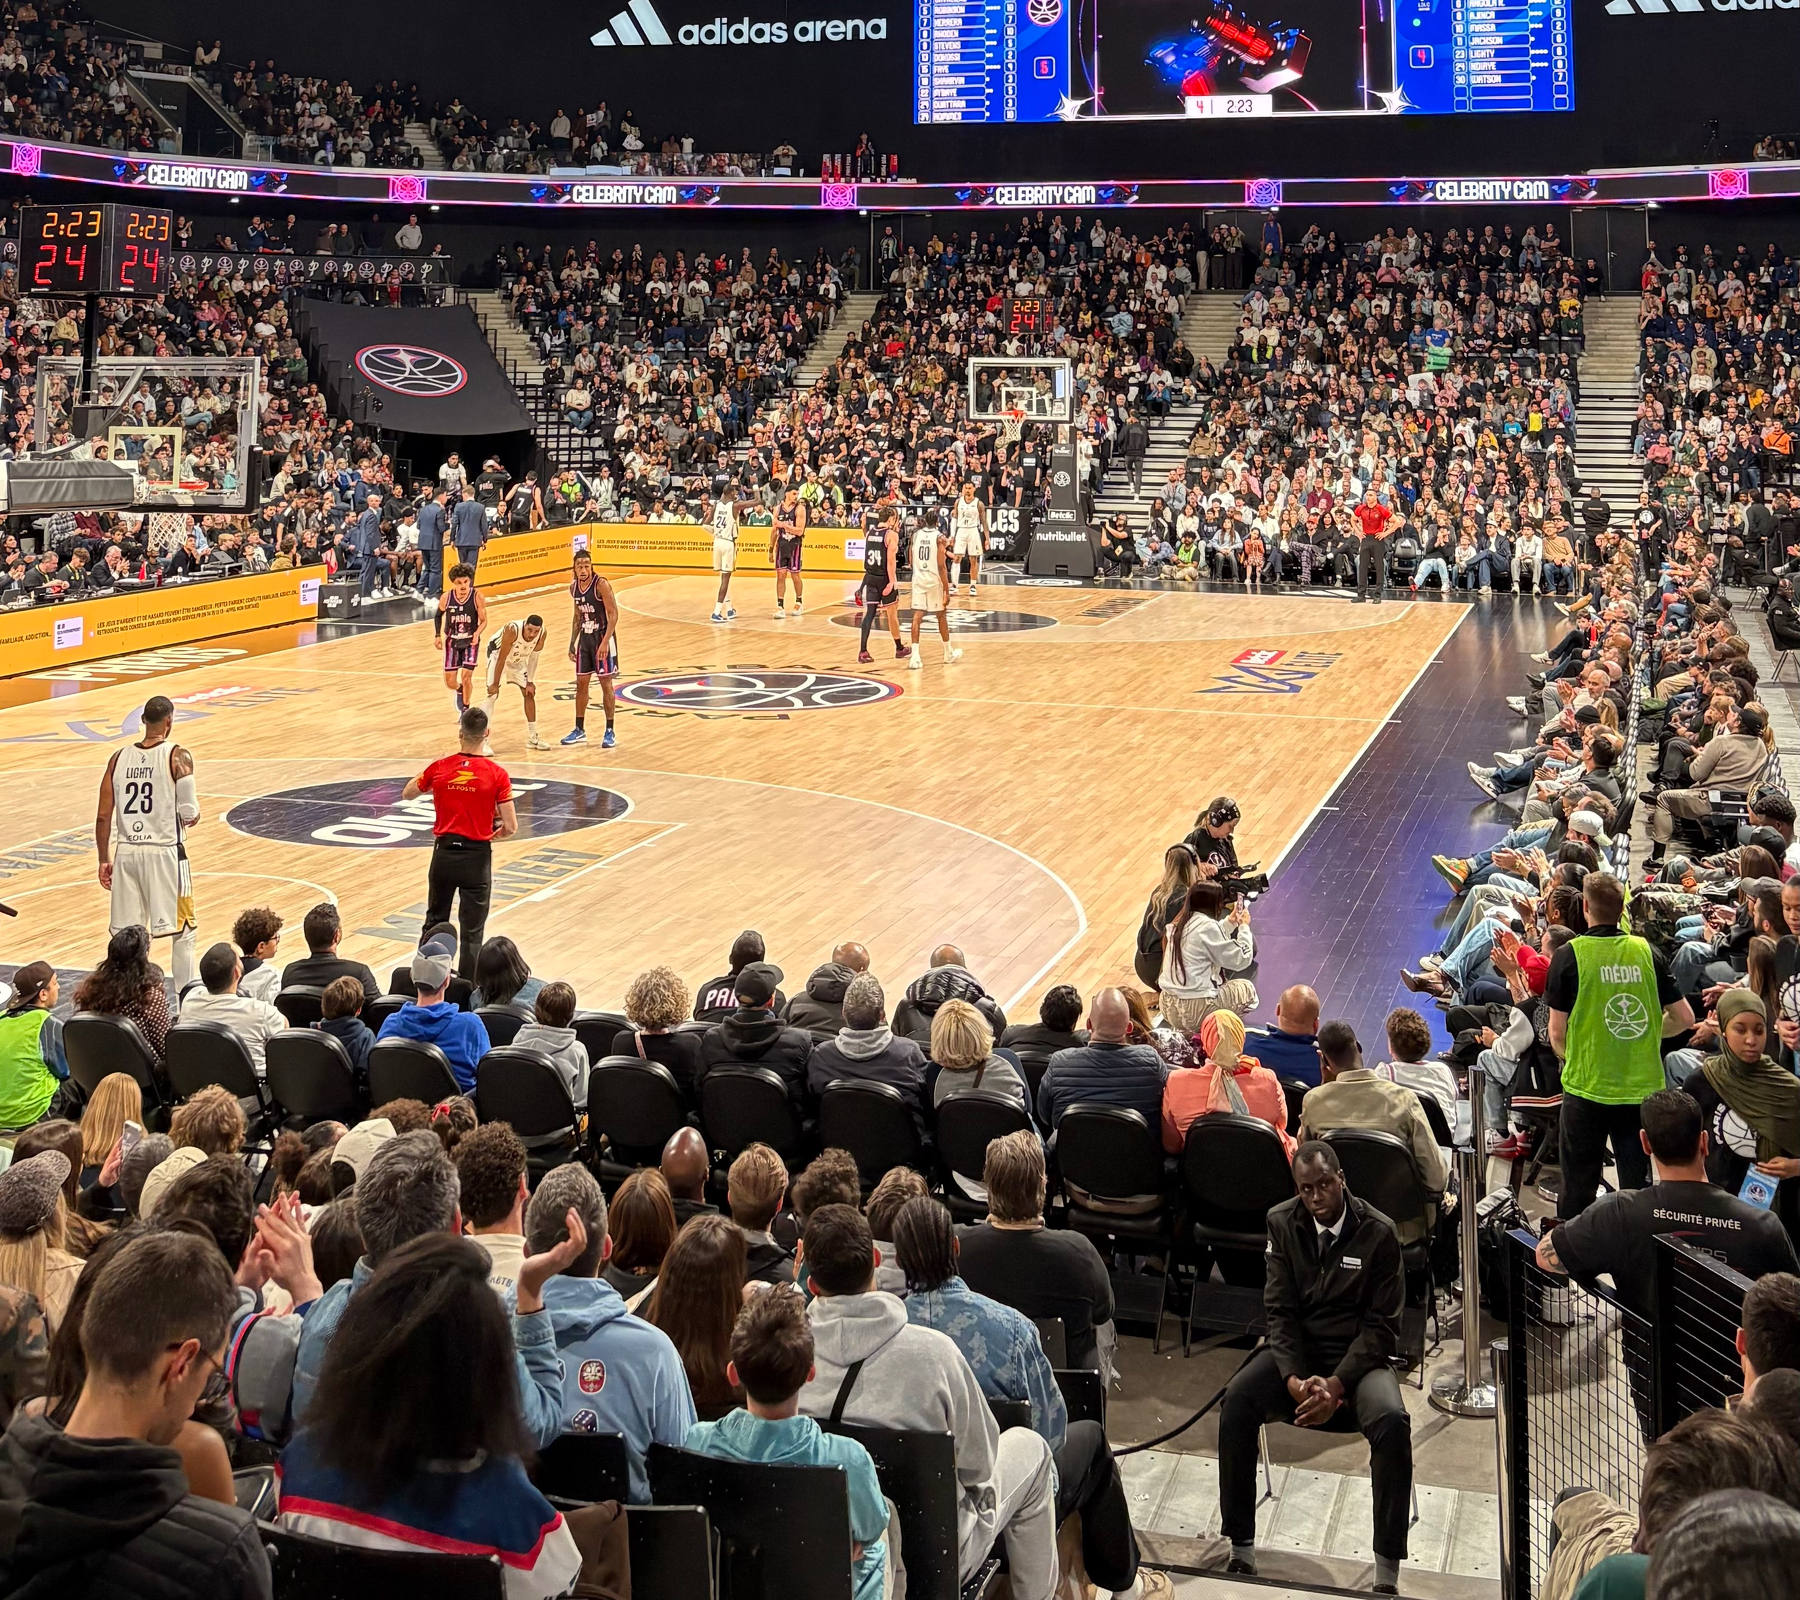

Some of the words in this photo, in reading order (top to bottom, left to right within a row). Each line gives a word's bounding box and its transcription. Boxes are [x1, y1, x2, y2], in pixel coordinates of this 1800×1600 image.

[678, 17, 788, 46] adidas
[793, 18, 887, 43] arena
[1196, 100, 1204, 113] 4
[1227, 100, 1253, 114] 2:23
[148, 165, 217, 188] CELEBRITY
[217, 170, 247, 190] CAM
[573, 185, 643, 203] CELEBRITY
[644, 185, 676, 204] CAM
[996, 186, 1063, 204] CELEBRITY
[1064, 185, 1095, 204] CAM
[1435, 181, 1511, 200] CELEBRITY
[1513, 180, 1549, 199] CAM
[42, 211, 101, 238] 2:23
[126, 213, 169, 241] 2:23
[34, 244, 87, 285] 24
[120, 244, 160, 285] 24
[1013, 300, 1040, 312] 2:23
[1010, 314, 1035, 330] 24
[517, 497, 525, 509] 7
[716, 516, 727, 529] 24
[1036, 531, 1087, 543] nutribullet.
[867, 550, 881, 566] 34
[451, 613, 472, 623] PARIS
[126, 767, 154, 779] LIGHTY
[457, 784, 476, 792] POSTE
[123, 782, 153, 814] 23
[1600, 963, 1642, 984] MÉDIA
[1712, 1103, 1727, 1145] PARIS
[1653, 1208, 1703, 1225] SÉCURITÉ
[1705, 1217, 1742, 1230] PRIVÉE
